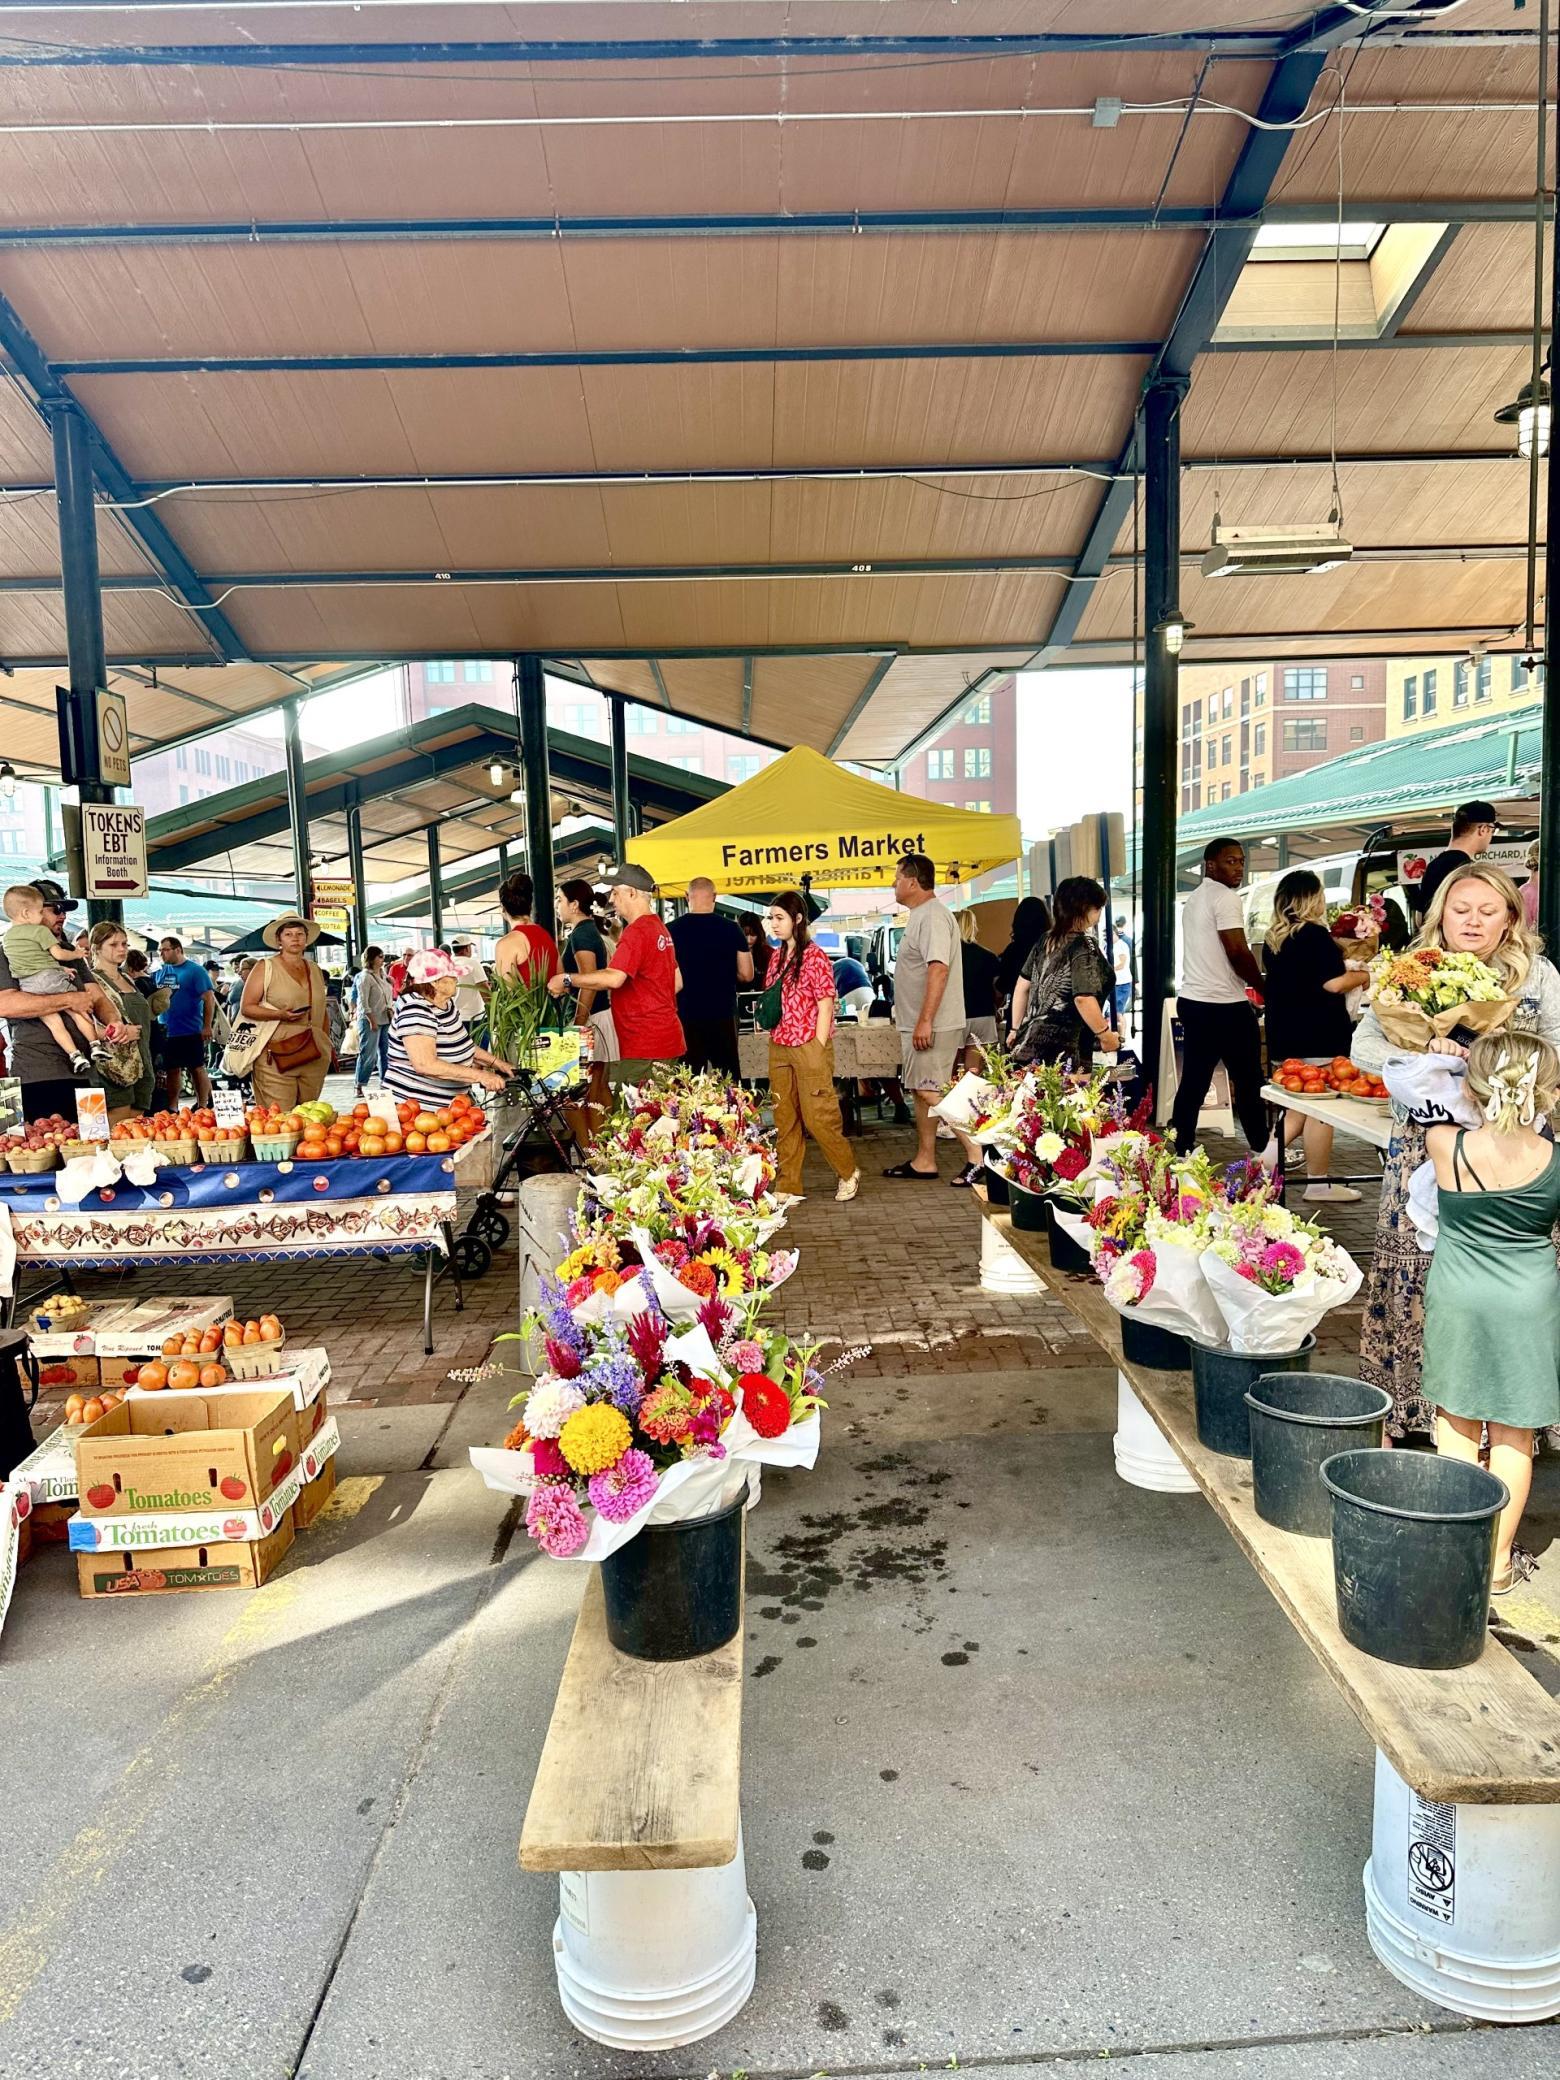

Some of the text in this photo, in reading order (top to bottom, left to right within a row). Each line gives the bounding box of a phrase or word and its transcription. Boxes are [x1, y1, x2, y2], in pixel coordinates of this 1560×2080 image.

[104, 755, 127, 772] NO PETS
[88, 812, 142, 833] TOKENS
[103, 832, 128, 853] EBT
[722, 833, 925, 867] Farmers Market
[95, 854, 138, 865] Information
[106, 866, 128, 878] Booth
[124, 1487, 213, 1510] Tomatoes
[269, 1479, 298, 1518] Tomatoes
[103, 1524, 220, 1547] Tomatoes
[105, 1575, 142, 1593] USA
[1415, 1886, 1436, 1901] AVISO
[1409, 1896, 1440, 1917] WARNING
